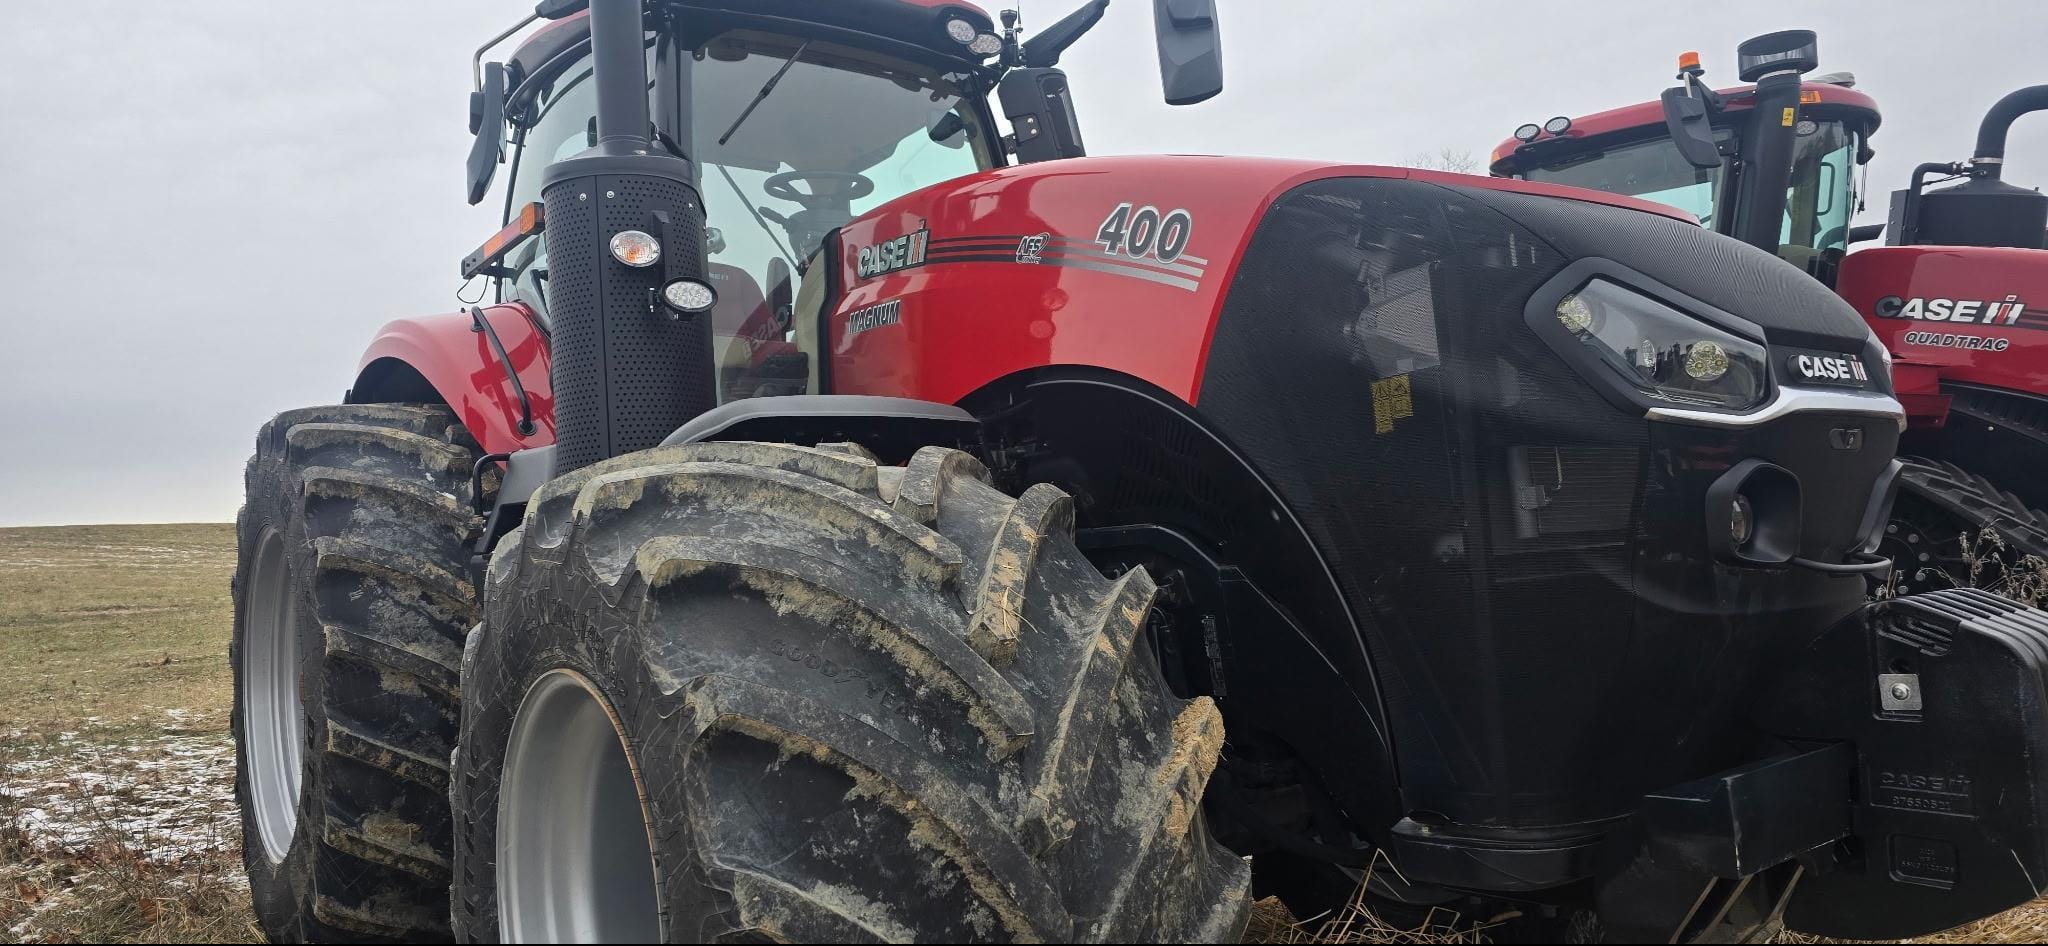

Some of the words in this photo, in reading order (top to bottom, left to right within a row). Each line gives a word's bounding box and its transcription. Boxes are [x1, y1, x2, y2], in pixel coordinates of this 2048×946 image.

[1095, 202, 1192, 264] 400
[857, 236, 907, 278] CASE
[848, 299, 901, 335] MAGNUM
[1875, 295, 1983, 323] CASE
[1904, 331, 2009, 351] QUADTRAC
[1798, 354, 1849, 380] CASE
[1880, 771, 1944, 790] CASE
